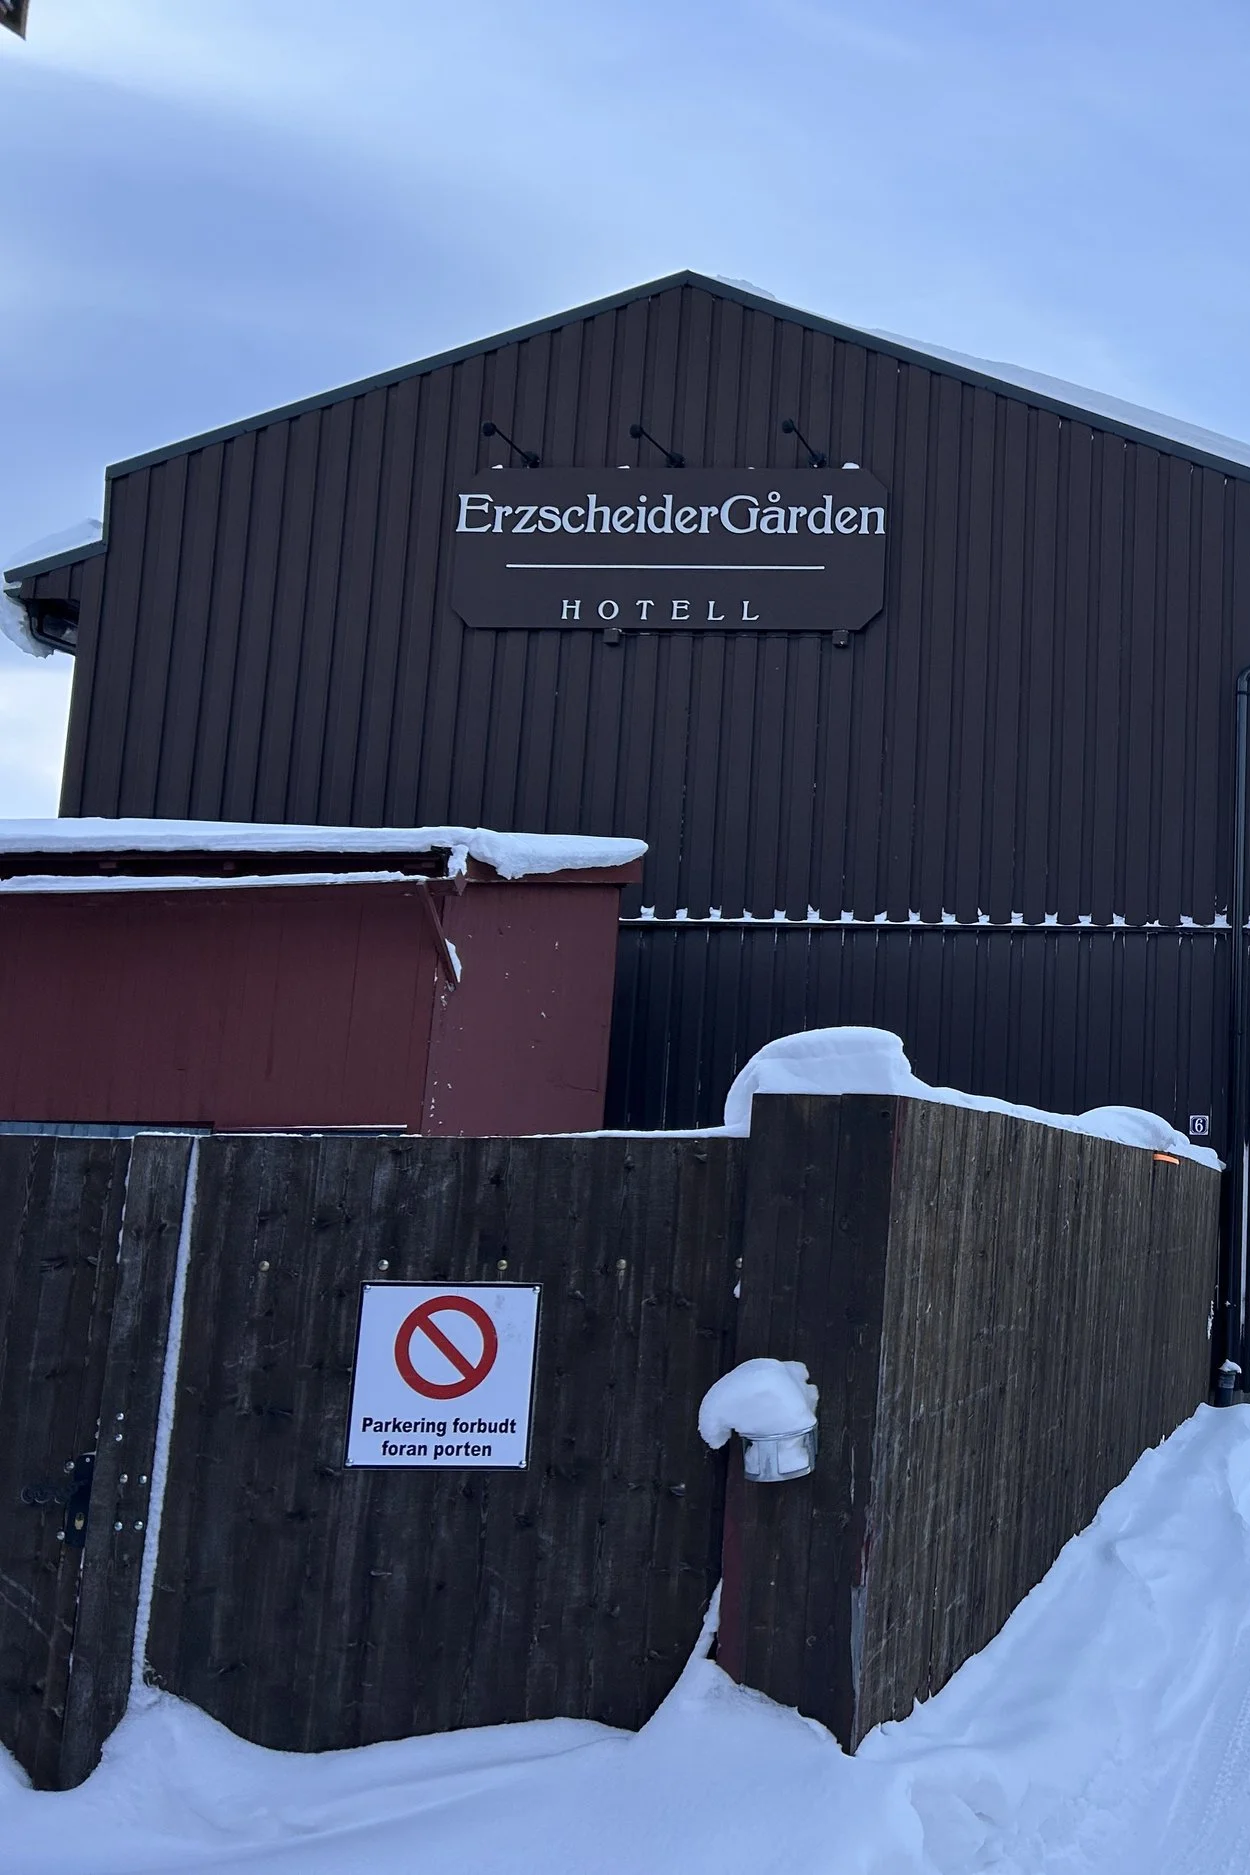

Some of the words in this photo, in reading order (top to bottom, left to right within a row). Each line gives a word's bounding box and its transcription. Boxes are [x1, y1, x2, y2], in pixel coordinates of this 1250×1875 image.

[455, 490, 886, 535] ErzscheiderGården
[560, 599, 760, 622] HOTELL
[1194, 1117, 1204, 1133] 6
[361, 1416, 447, 1437] Parkering
[452, 1417, 517, 1434] forbudt
[381, 1440, 428, 1457] foran
[433, 1441, 492, 1460] porten
